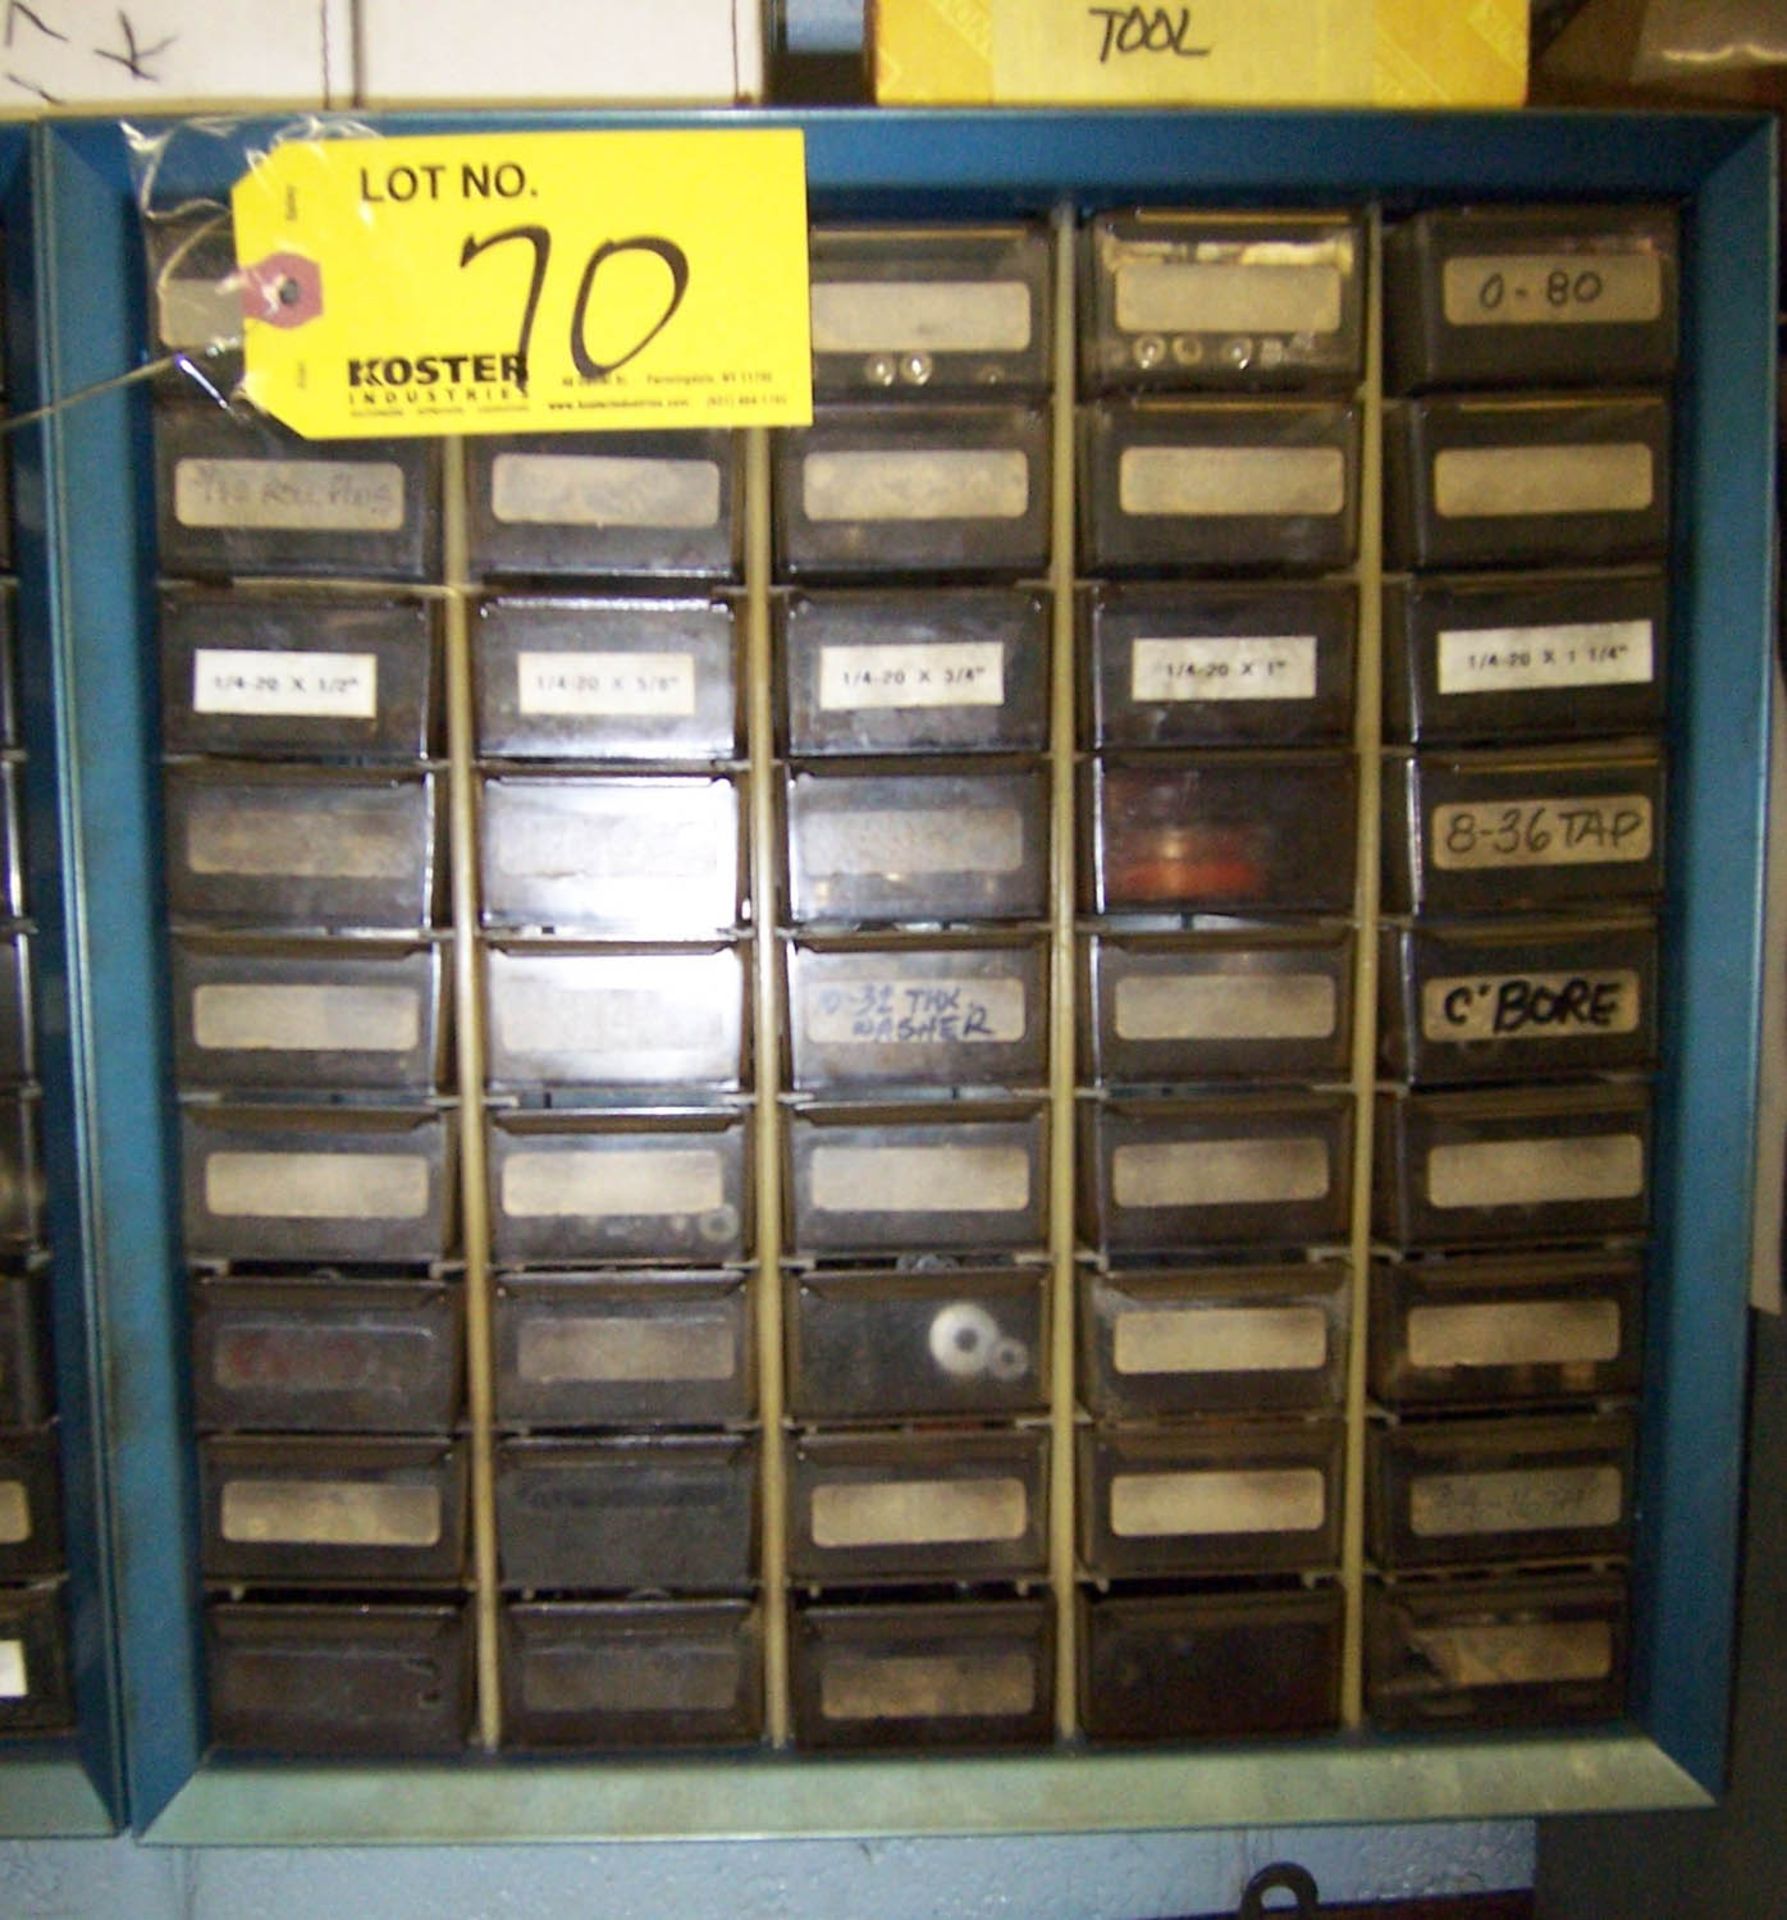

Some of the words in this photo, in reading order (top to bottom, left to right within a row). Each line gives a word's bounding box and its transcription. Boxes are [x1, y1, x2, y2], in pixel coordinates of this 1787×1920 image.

[1088, 5, 1211, 64] TOOL
[360, 165, 446, 202] LOT
[461, 163, 539, 199] NO.
[459, 224, 690, 394] 70
[347, 353, 529, 388] KOSTER
[1446, 807, 1551, 854] 8-36
[1557, 808, 1643, 848] TAP
